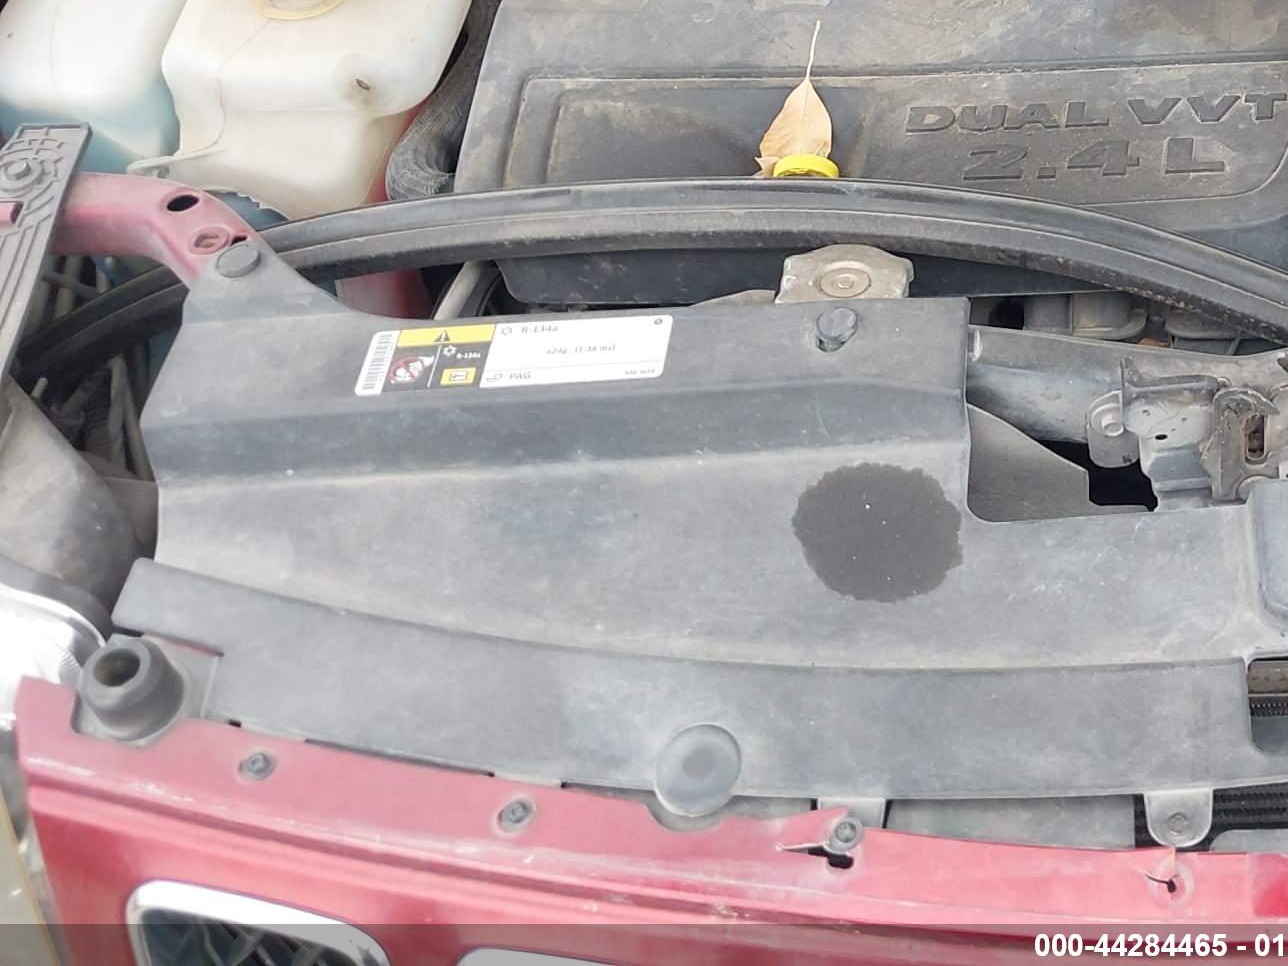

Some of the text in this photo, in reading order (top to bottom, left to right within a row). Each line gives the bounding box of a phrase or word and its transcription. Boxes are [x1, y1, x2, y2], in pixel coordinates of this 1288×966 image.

[905, 92, 1288, 134] DUAL VVT
[509, 372, 532, 380] PAG
